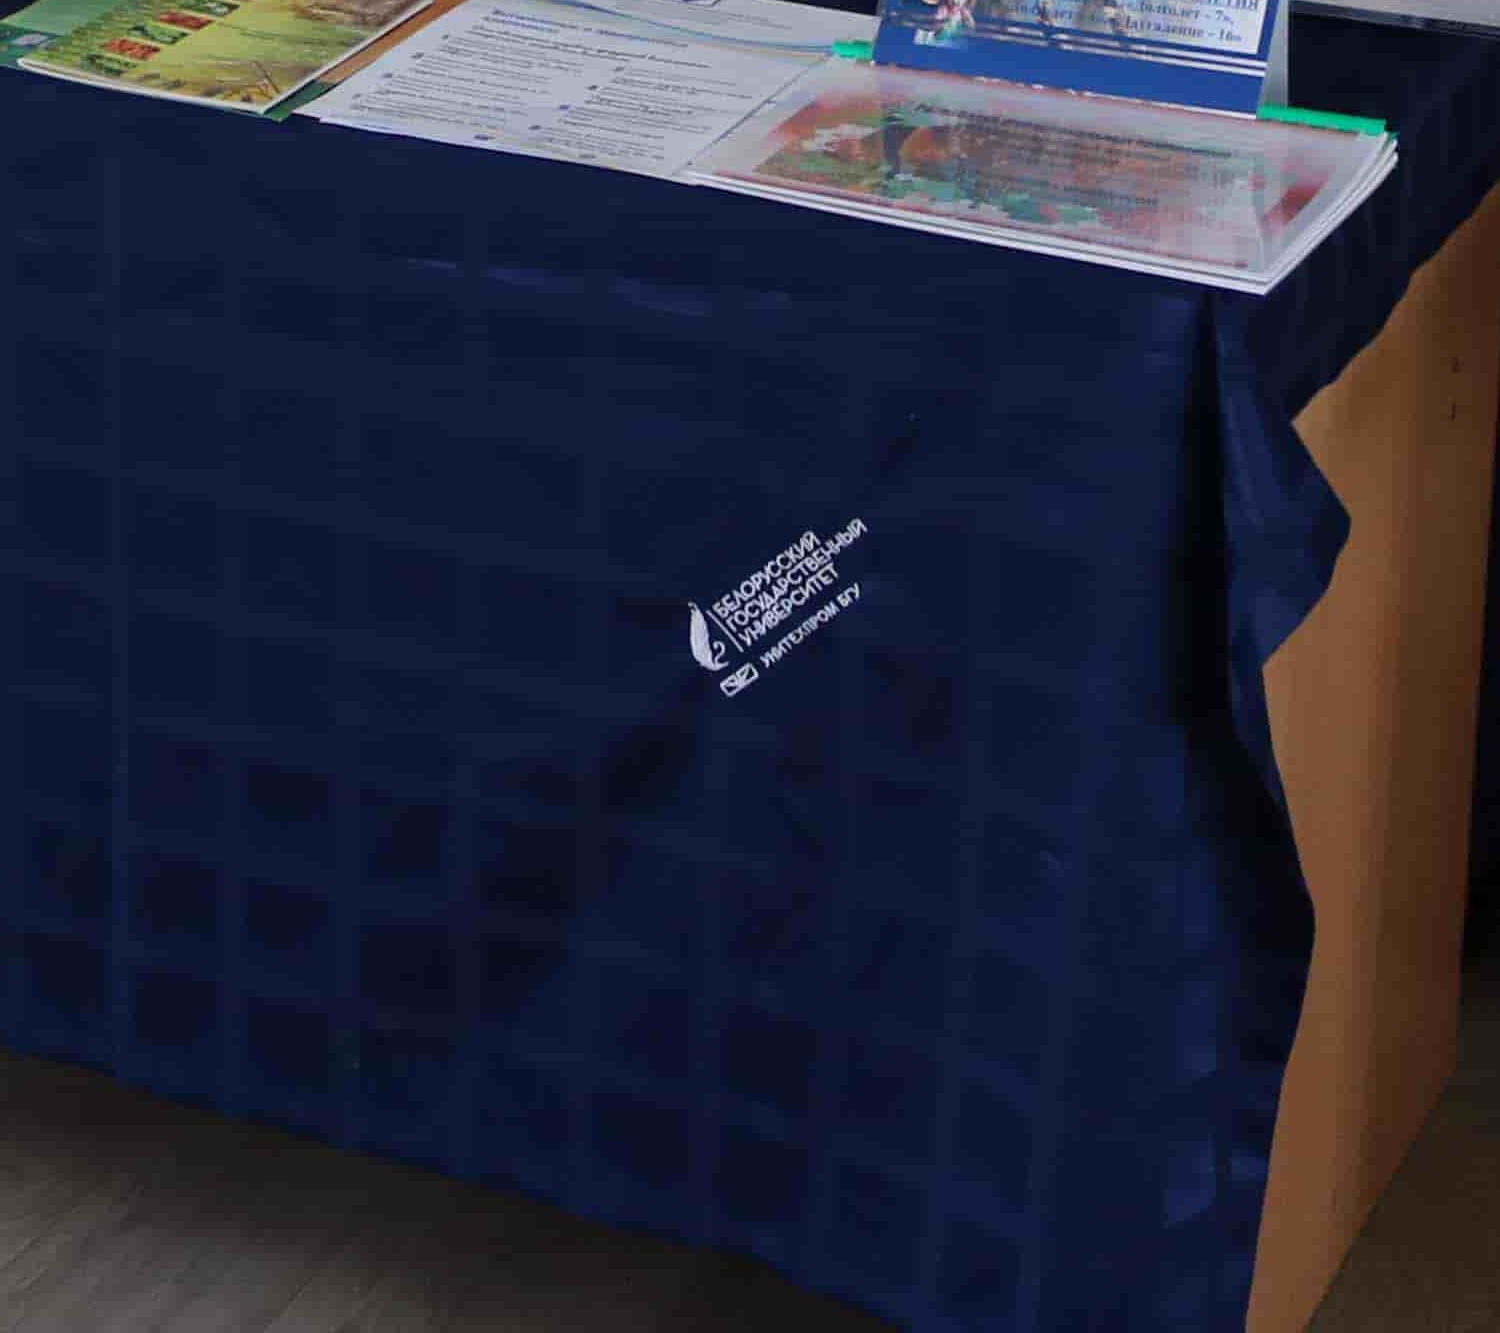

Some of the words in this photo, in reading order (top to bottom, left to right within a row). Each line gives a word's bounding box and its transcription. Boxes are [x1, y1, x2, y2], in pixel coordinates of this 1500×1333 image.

[711, 529, 821, 619] БЕЛОРУССКИЙ
[725, 517, 869, 633] ГОСУДАРСТВЕННЫЙ
[738, 563, 841, 648] УНИВЕРСИТЕТ
[759, 601, 841, 668] УНИТЕХПРОМ
[835, 581, 862, 608] БГУ
